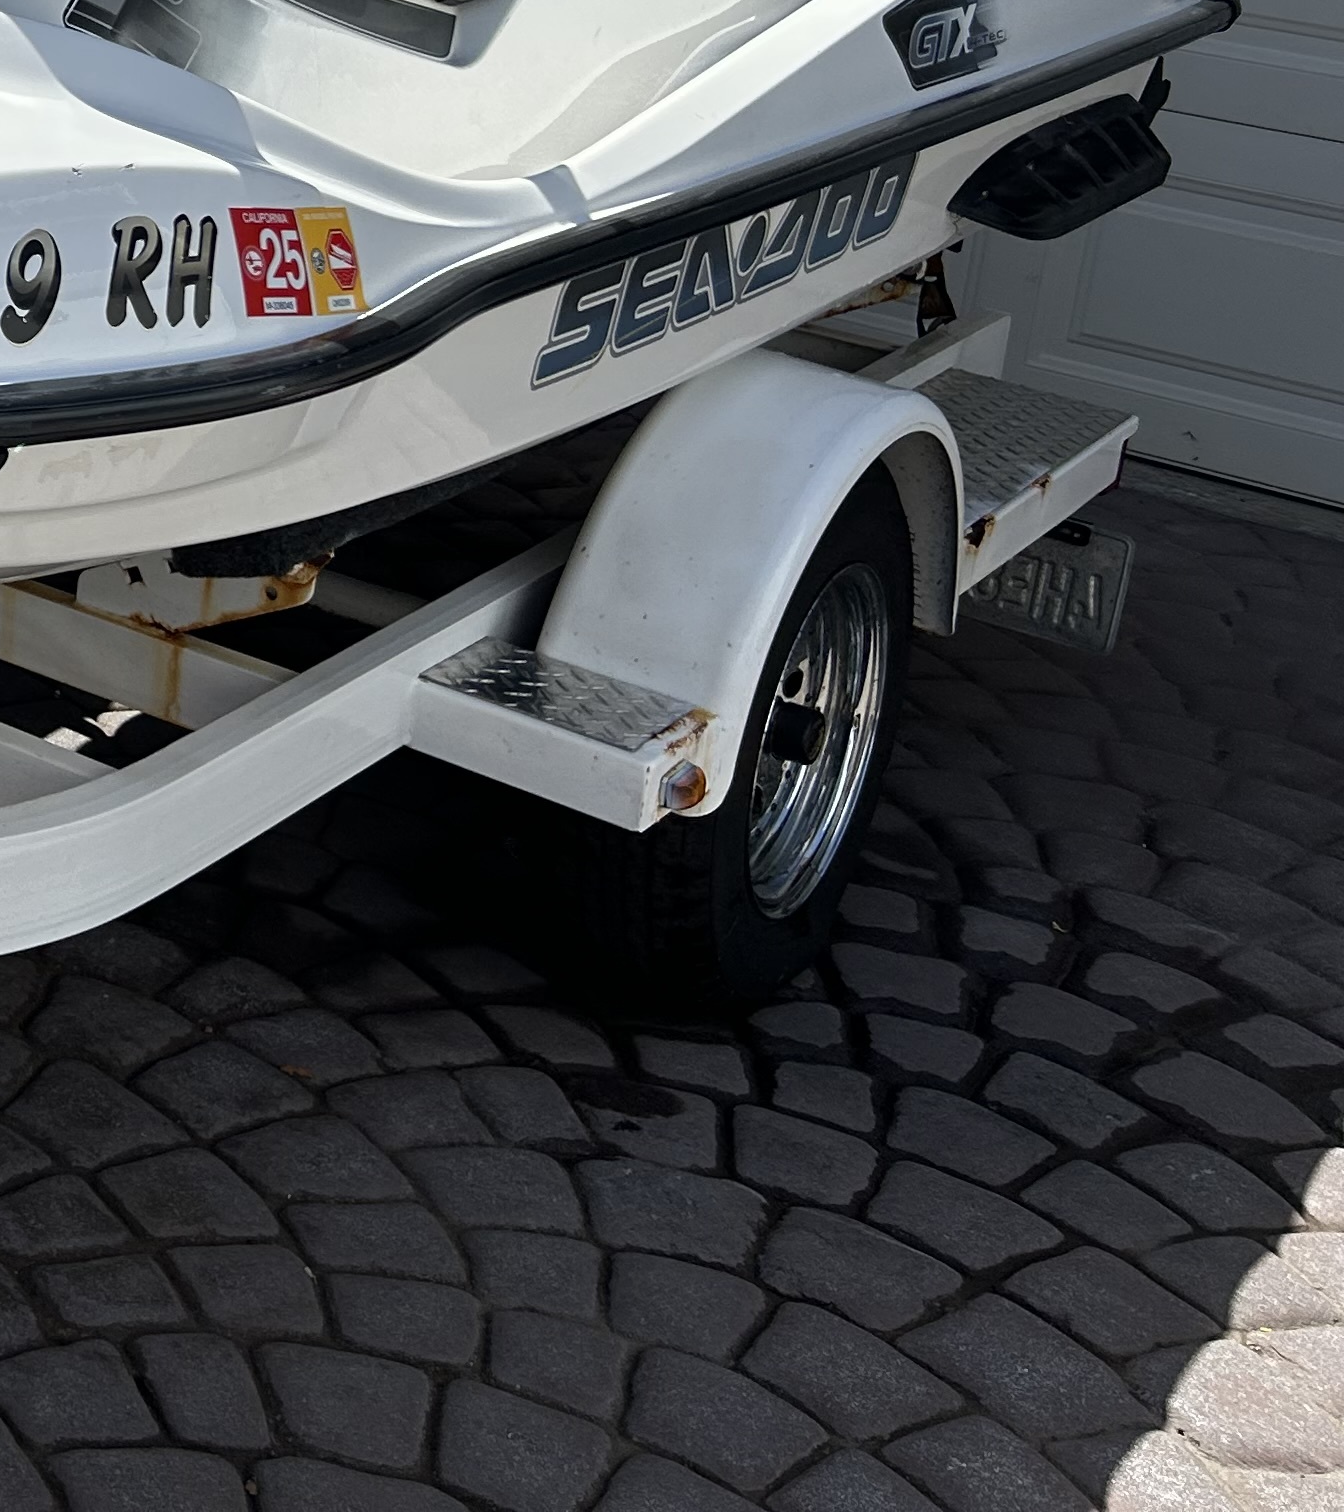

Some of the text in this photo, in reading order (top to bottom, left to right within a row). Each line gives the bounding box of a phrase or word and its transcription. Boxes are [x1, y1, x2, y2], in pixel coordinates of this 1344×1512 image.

[909, 0, 977, 69] GTX
[242, 212, 289, 224] CALIFORNIA
[105, 211, 219, 331] RH
[259, 227, 307, 291] 25
